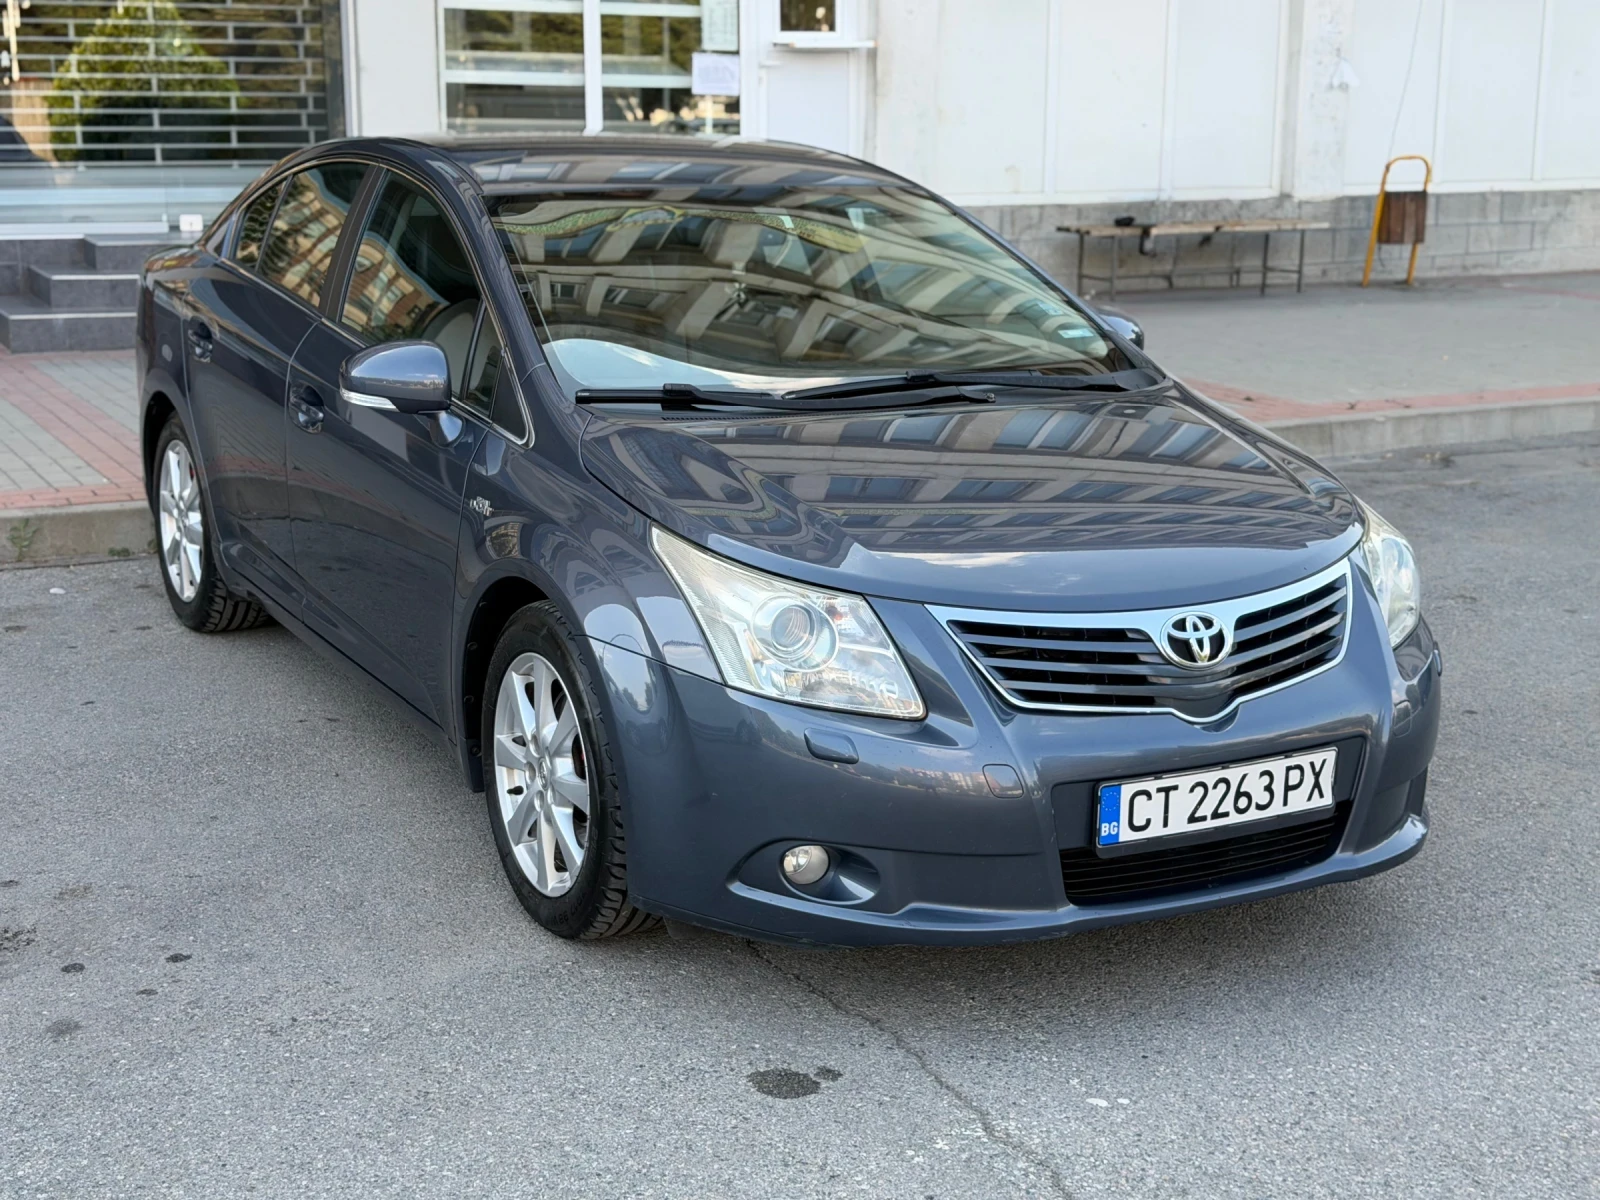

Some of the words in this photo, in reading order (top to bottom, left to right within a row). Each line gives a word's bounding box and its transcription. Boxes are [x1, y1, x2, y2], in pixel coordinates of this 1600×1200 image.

[1127, 785, 1179, 833] CT
[1187, 769, 1275, 824] 2263
[1283, 758, 1328, 808] PX
[1101, 821, 1119, 837] BG
